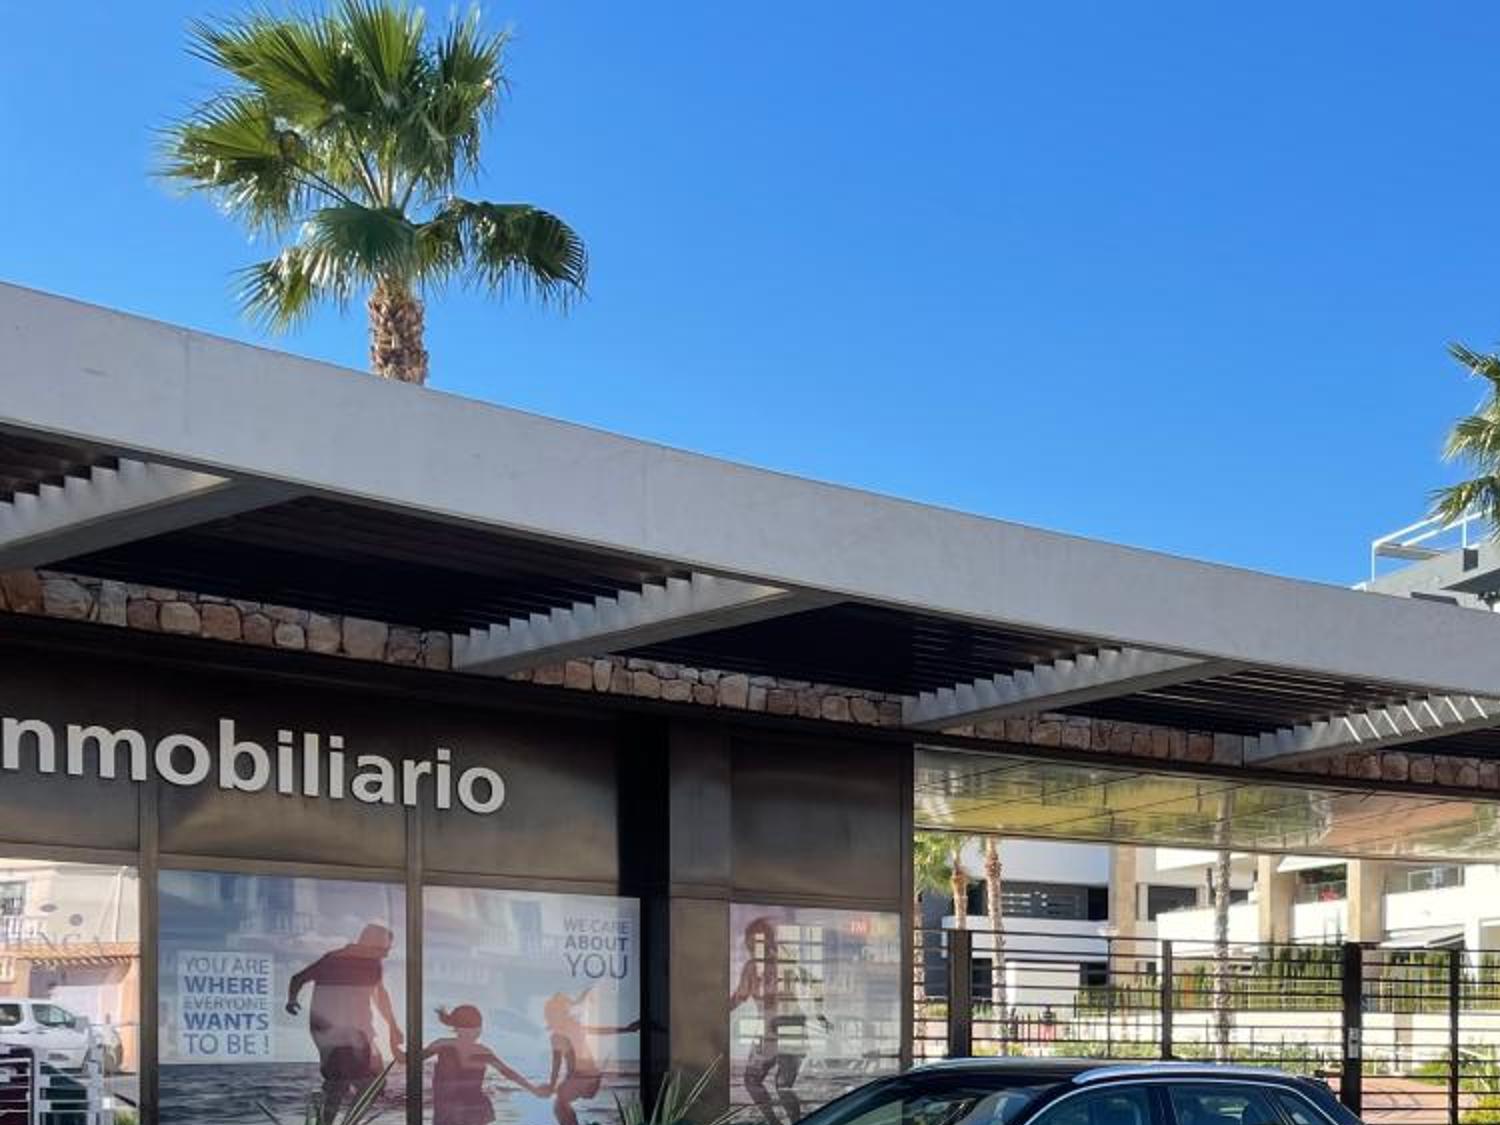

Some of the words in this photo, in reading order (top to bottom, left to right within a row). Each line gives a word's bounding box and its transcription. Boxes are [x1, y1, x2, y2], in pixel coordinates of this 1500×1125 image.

[3, 717, 505, 813] nmobiliario
[564, 934, 628, 951] ABOUT
[185, 957, 226, 973] YOU
[231, 958, 270, 975] ARE
[563, 953, 628, 979] YOU
[184, 975, 269, 995] WHERE
[183, 995, 270, 1011] EVERYONE
[184, 1012, 269, 1031] WANTS
[183, 1033, 219, 1055] TO
